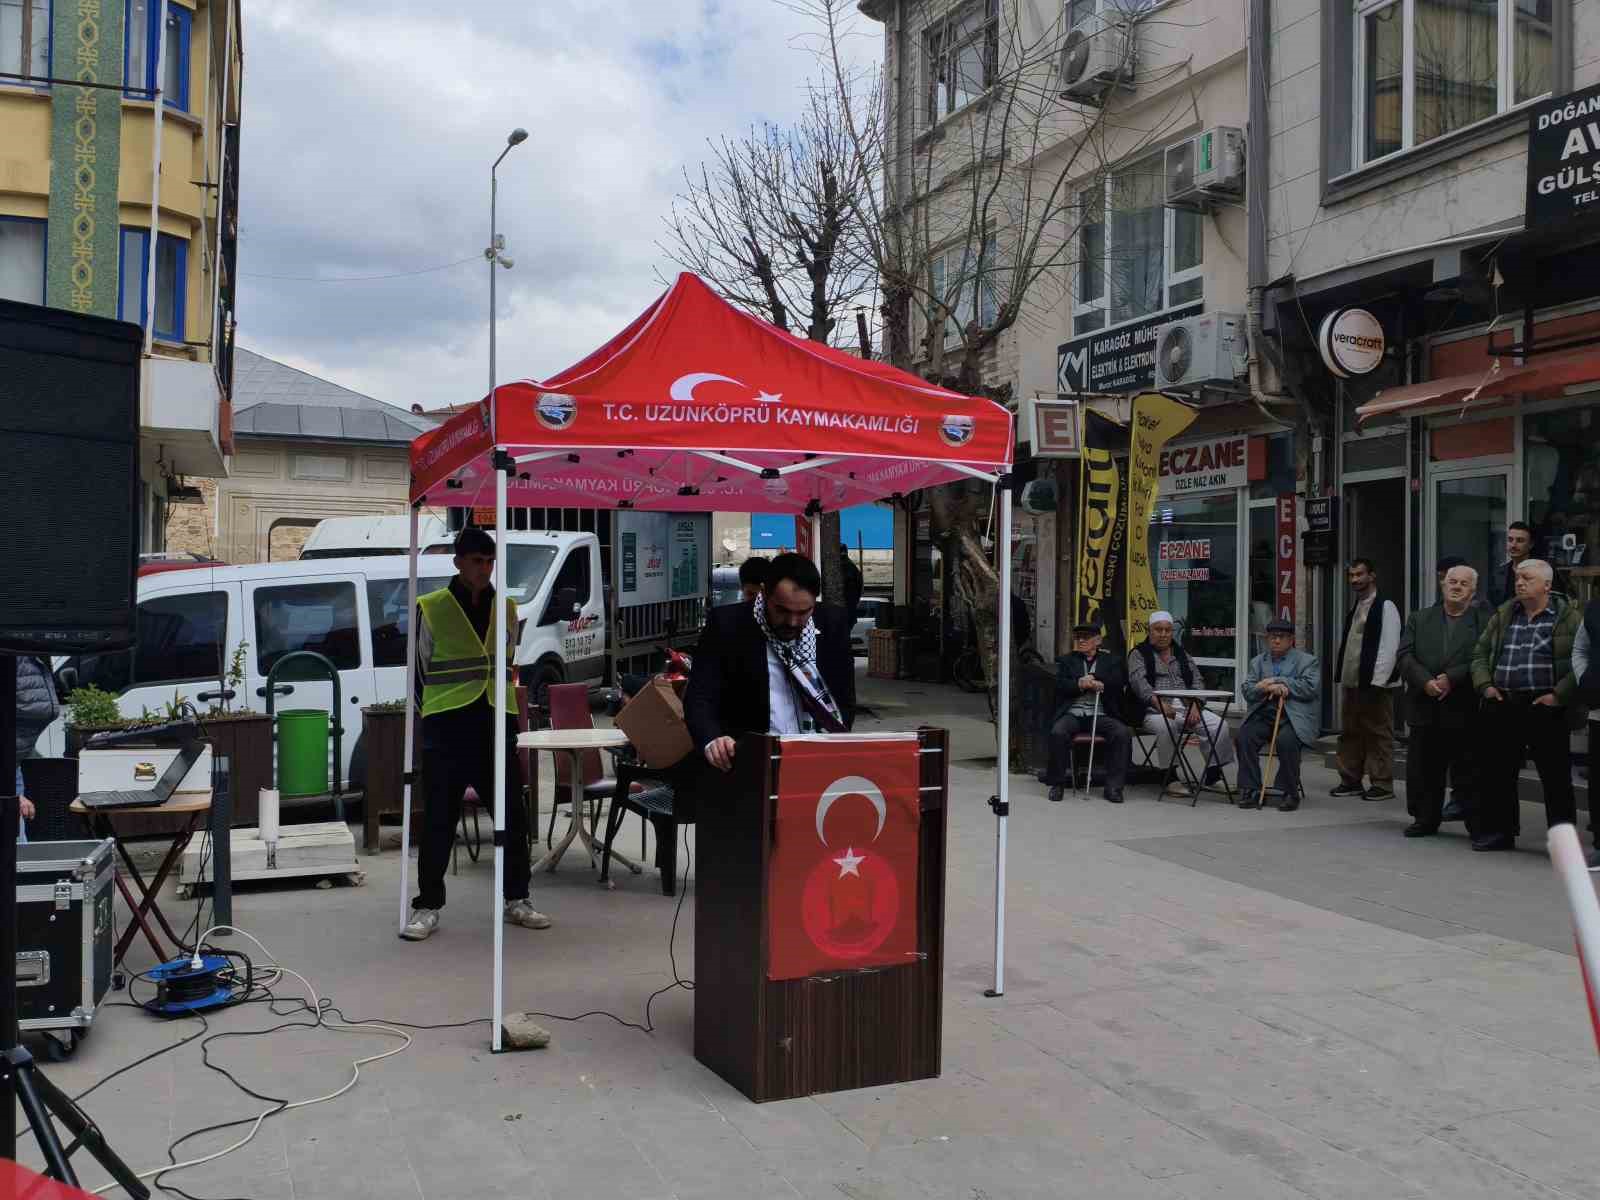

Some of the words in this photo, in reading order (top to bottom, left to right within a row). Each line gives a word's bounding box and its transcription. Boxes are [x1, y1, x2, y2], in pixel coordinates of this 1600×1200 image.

[1093, 332, 1131, 356] KARAGÖZ
[1333, 332, 1383, 349] veracraft
[602, 404, 639, 421] T.C.
[645, 402, 769, 425] UZUNKÖPRÜ
[776, 409, 920, 435] KAYMAKAMLIĞI
[1044, 411, 1071, 445] E
[1158, 439, 1245, 477] ECZANE
[1160, 539, 1210, 560] ECZANE
